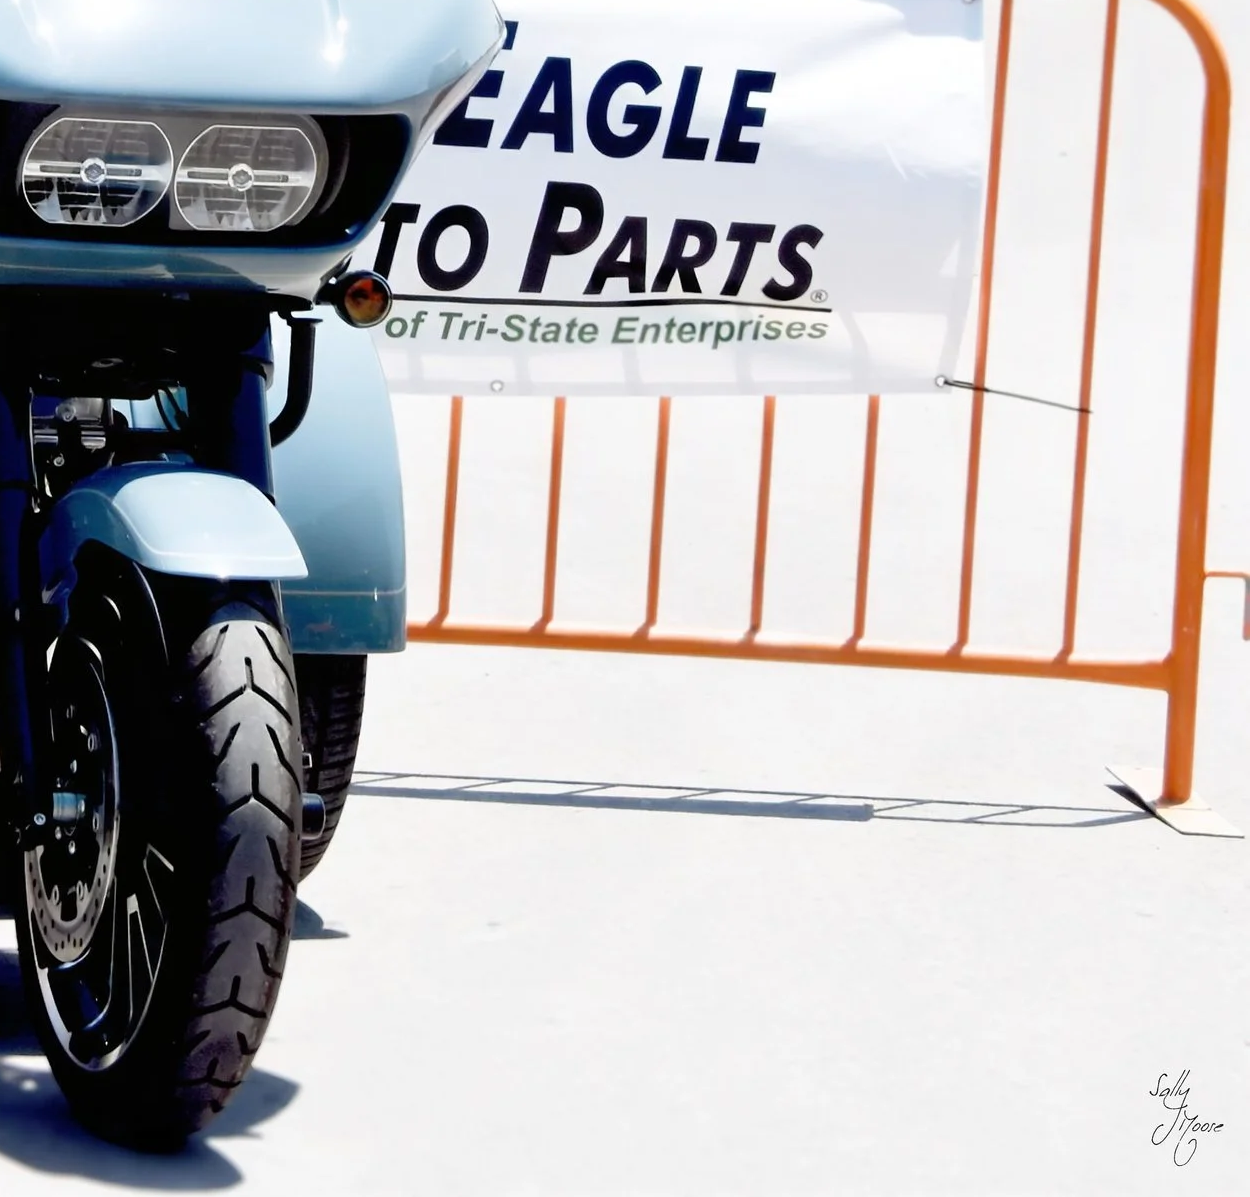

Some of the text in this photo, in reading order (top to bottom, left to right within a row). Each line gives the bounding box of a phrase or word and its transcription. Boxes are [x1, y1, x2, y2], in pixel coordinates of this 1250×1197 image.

[385, 310, 830, 349] of Tri-State Enterprises
